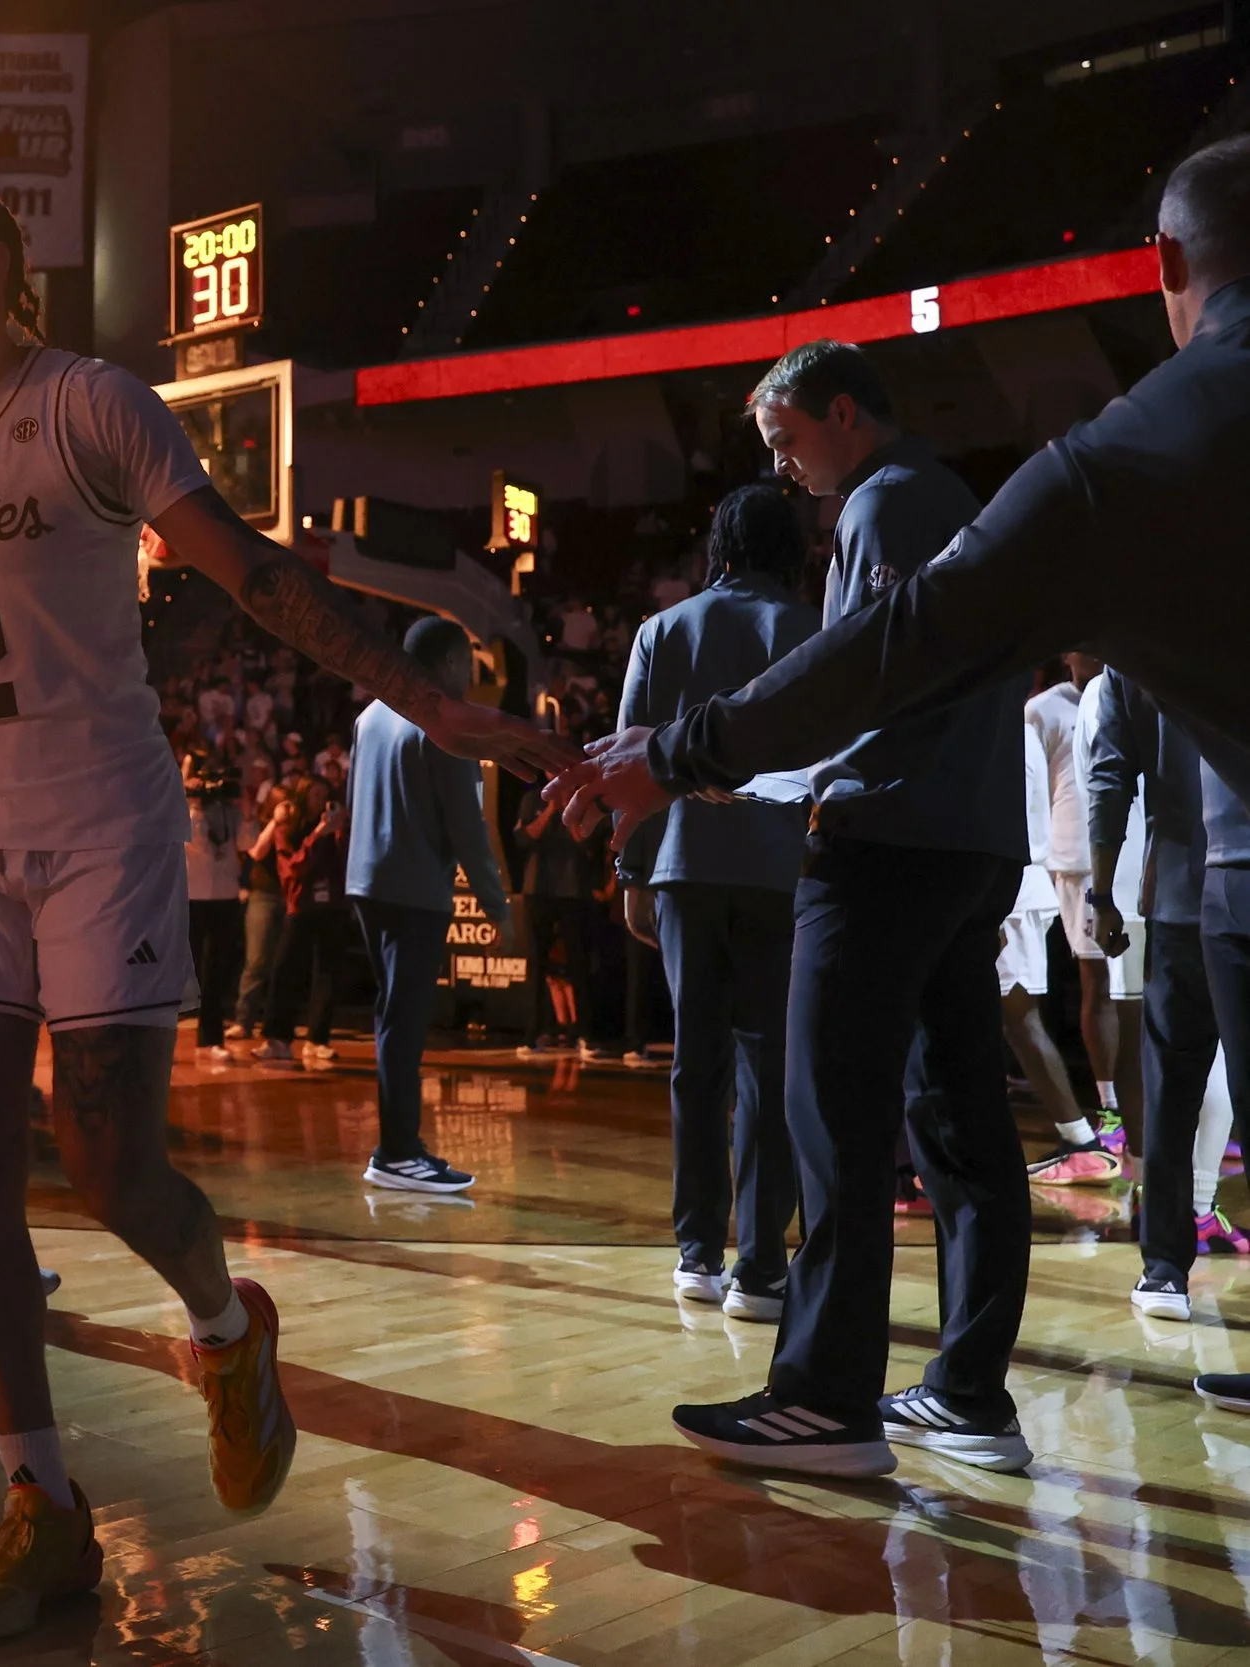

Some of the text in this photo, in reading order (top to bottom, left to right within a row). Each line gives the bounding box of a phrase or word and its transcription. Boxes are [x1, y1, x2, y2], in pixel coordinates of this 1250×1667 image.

[183, 219, 256, 269] 20:00
[193, 257, 248, 325] 30
[911, 286, 940, 333] 5
[16, 420, 36, 440] SEC
